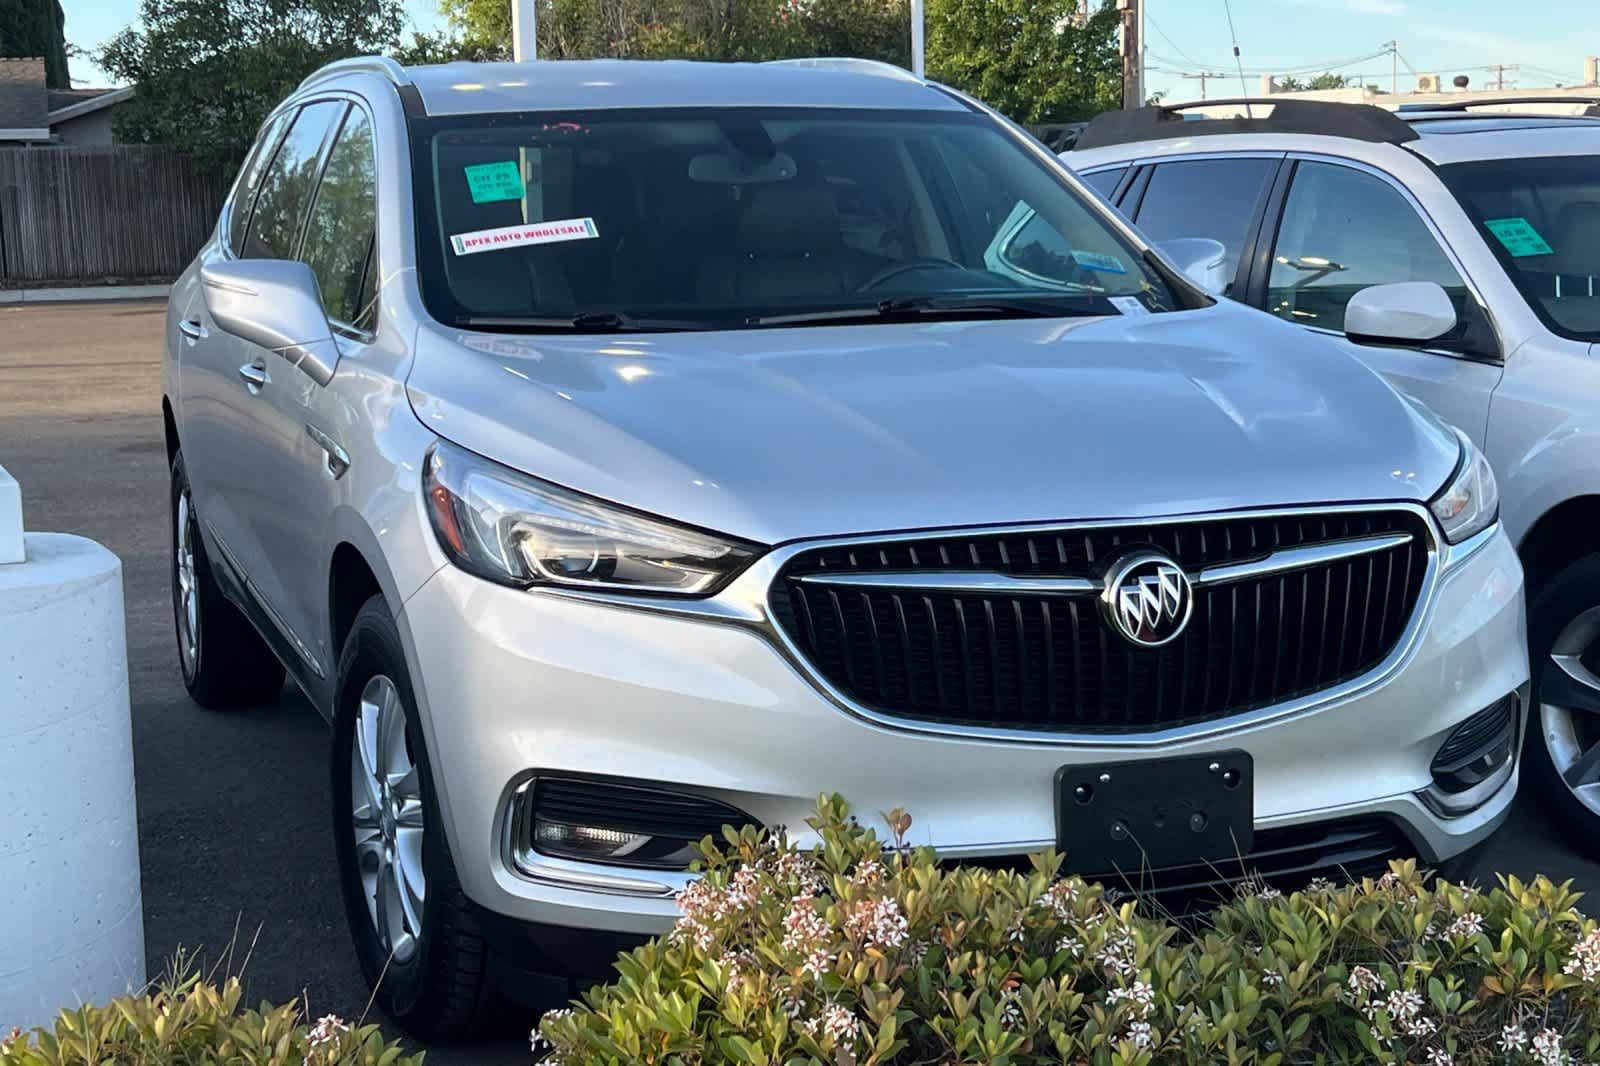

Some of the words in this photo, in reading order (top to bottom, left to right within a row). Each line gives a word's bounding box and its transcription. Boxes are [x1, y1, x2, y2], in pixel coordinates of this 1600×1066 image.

[464, 236, 491, 247] APEX
[493, 232, 521, 243] AUTO
[523, 225, 585, 239] WHOLESALE
